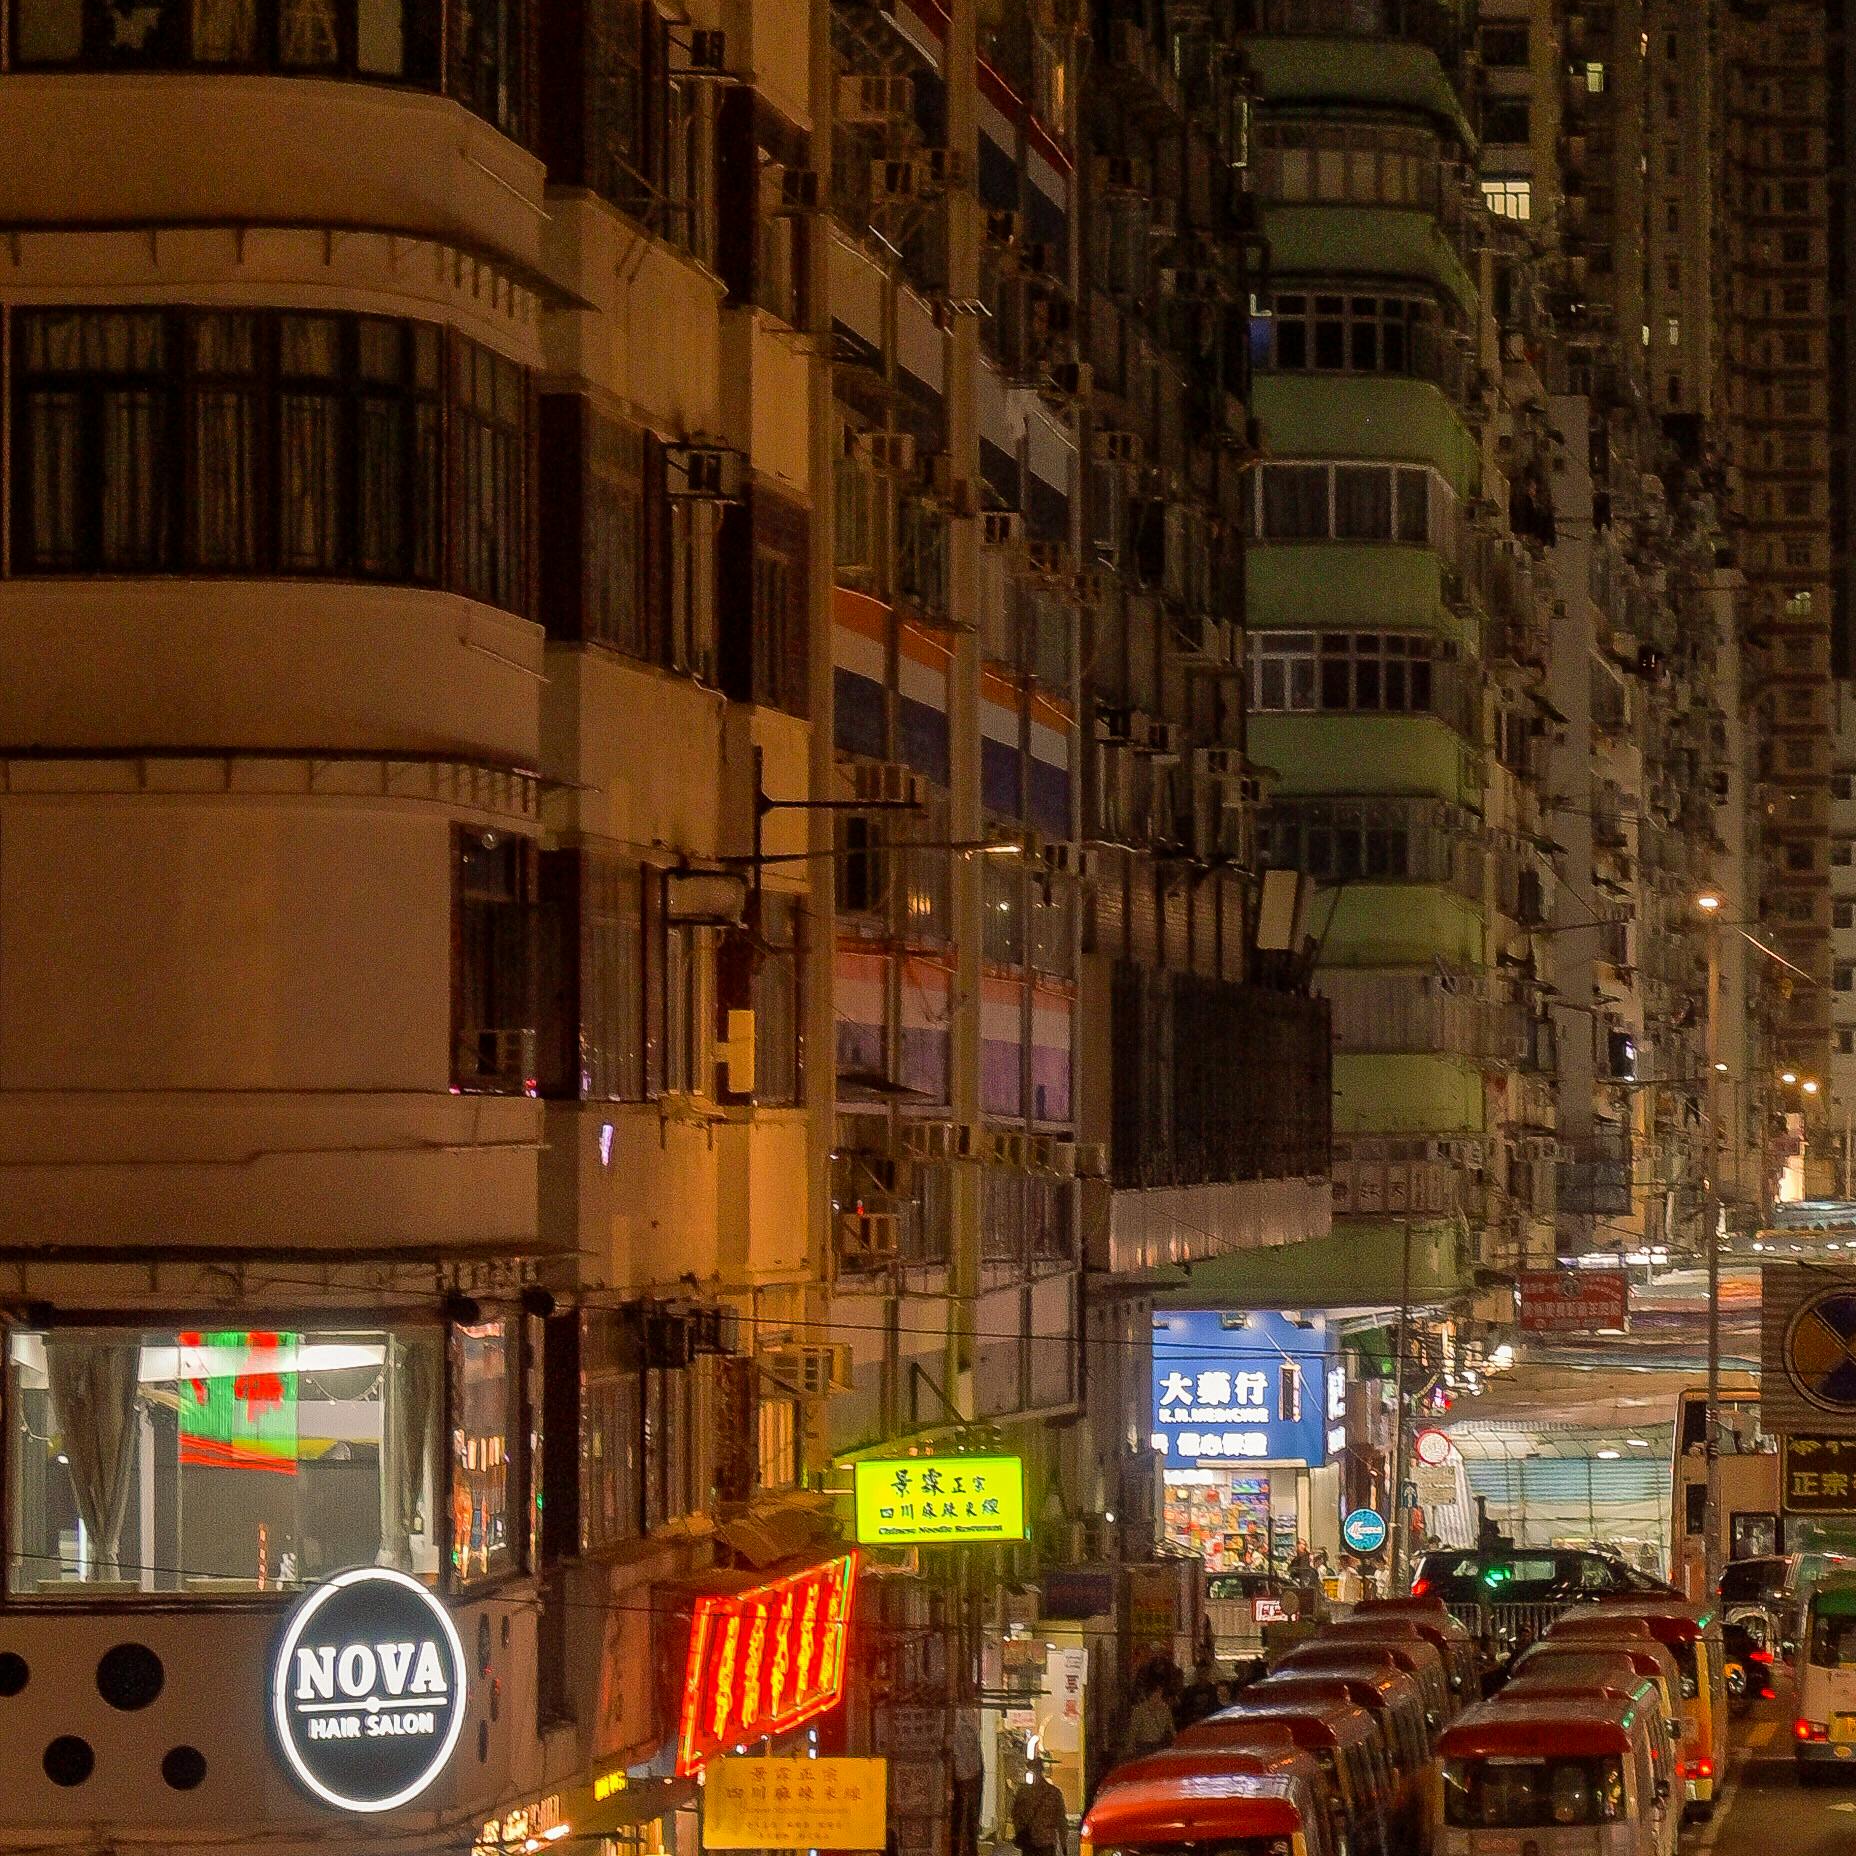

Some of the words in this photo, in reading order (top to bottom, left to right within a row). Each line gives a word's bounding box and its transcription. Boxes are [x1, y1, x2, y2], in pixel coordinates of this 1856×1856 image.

[295, 1641, 448, 1701] NOVA
[309, 1717, 360, 1740] HAIR
[367, 1713, 435, 1737] SALON
